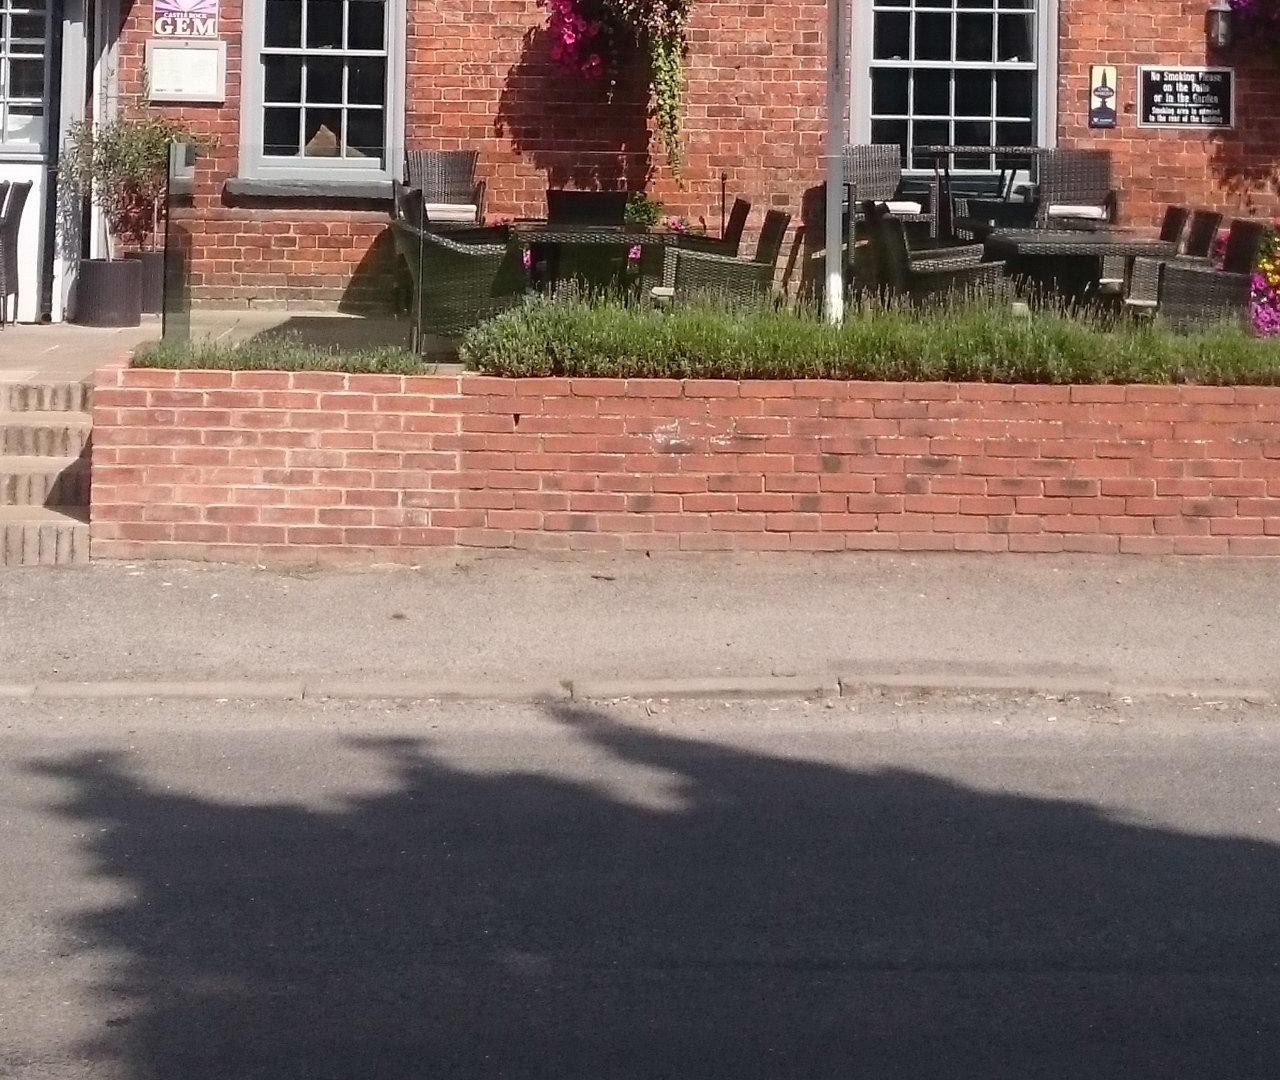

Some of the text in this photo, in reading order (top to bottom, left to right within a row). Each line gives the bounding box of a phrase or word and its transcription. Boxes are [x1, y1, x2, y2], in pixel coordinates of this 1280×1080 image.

[155, 16, 216, 36] GEM
[1151, 71, 1160, 81] No
[1163, 71, 1196, 82] Smoking
[1162, 83, 1173, 92] on
[1175, 82, 1189, 92] the
[1153, 93, 1164, 103] or
[1177, 92, 1190, 103] the
[1192, 92, 1219, 103] Garden
